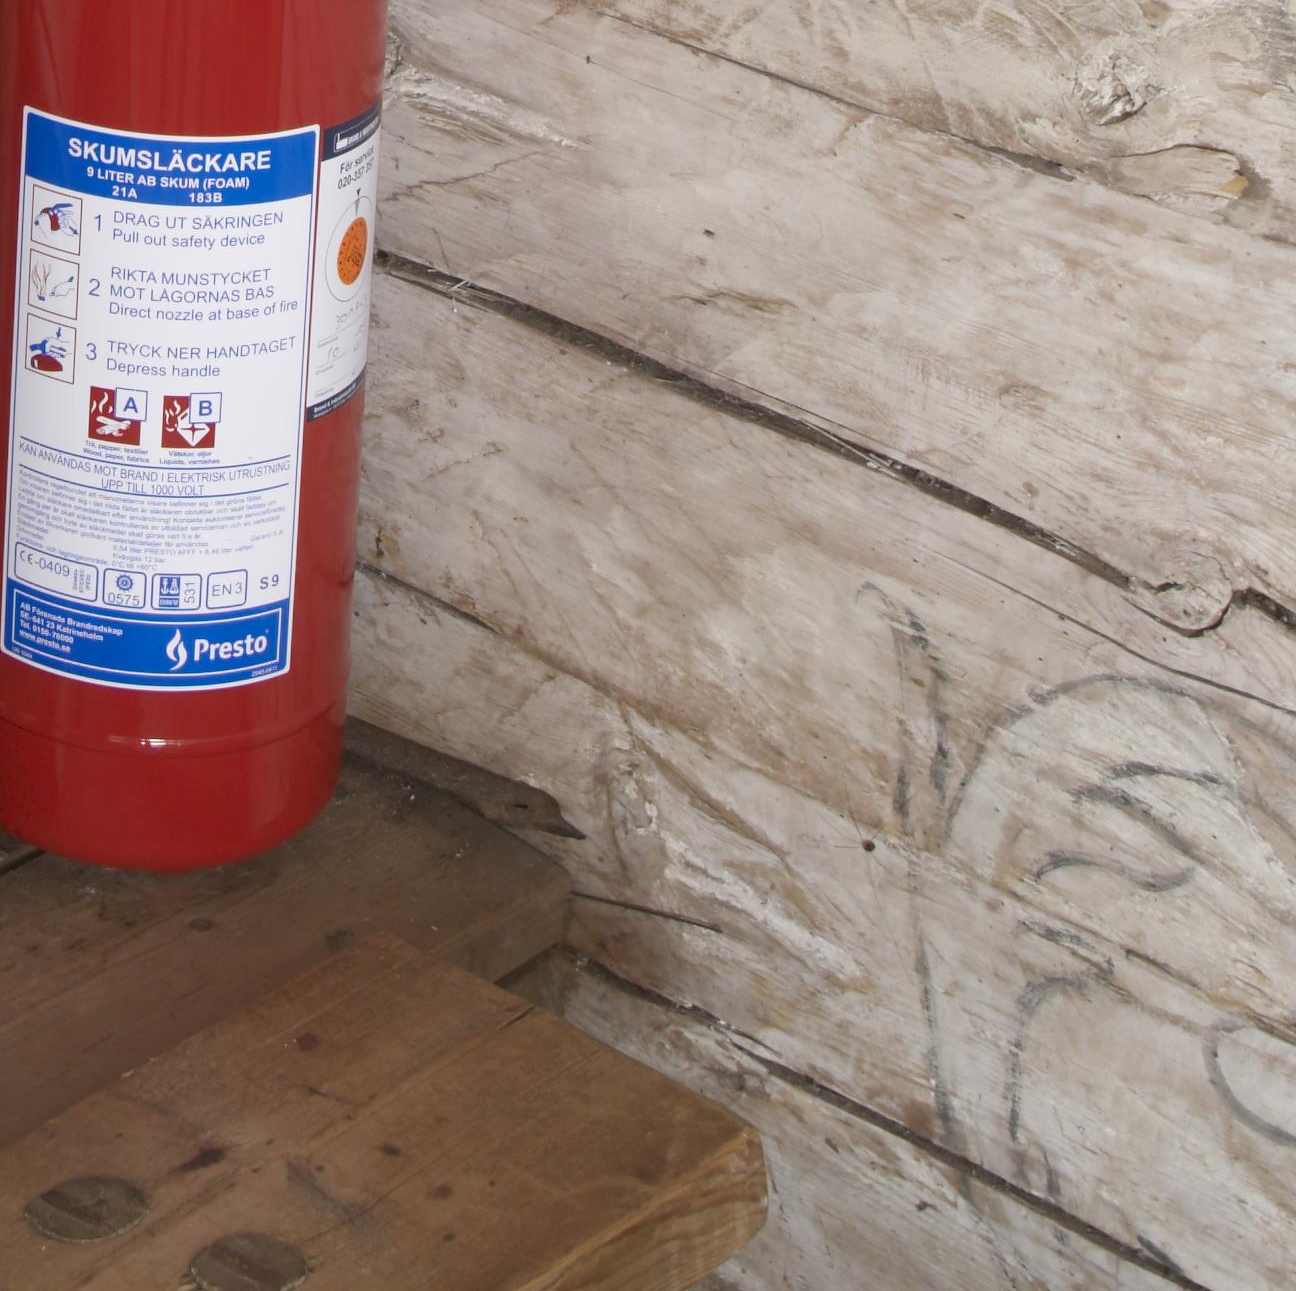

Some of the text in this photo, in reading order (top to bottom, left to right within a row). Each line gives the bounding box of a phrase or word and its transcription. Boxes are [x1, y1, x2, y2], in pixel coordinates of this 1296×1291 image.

[68, 137, 272, 173] SKUMSLÄCKARE
[86, 166, 250, 191] 9 LITER AB SKUM (FOAM)
[112, 185, 222, 204] 21A 183B
[94, 214, 102, 233] 1
[113, 211, 284, 231] DRAG UT SÄKRINGEN
[113, 228, 265, 251] Pull out safety device
[111, 266, 272, 287] RIKTA MUNSTYCKET
[88, 279, 101, 297] 2
[110, 284, 146, 299] MOT
[245, 285, 275, 301] BAS
[109, 299, 298, 321] Direct nozzle at base of fire
[85, 343, 97, 361] 3
[107, 340, 162, 359] TRYCK
[166, 346, 202, 359] NER
[206, 336, 296, 359] HANDTAGET
[106, 358, 222, 378] Depress handle
[123, 397, 138, 414] A
[198, 399, 213, 417] B
[19, 441, 37, 457] KAN
[38, 450, 92, 473] ANVÄNDAS
[94, 464, 118, 478] MOT
[120, 468, 158, 483] BRAND
[167, 472, 226, 483] ELEKTRISK
[229, 460, 291, 481] UTRUSTNING
[101, 479, 205, 496] UPP TILL 1000 VOLT
[184, 582, 196, 604] 531
[212, 581, 242, 597] EN 3
[107, 592, 140, 607] 0575
[194, 634, 268, 661] Presto
